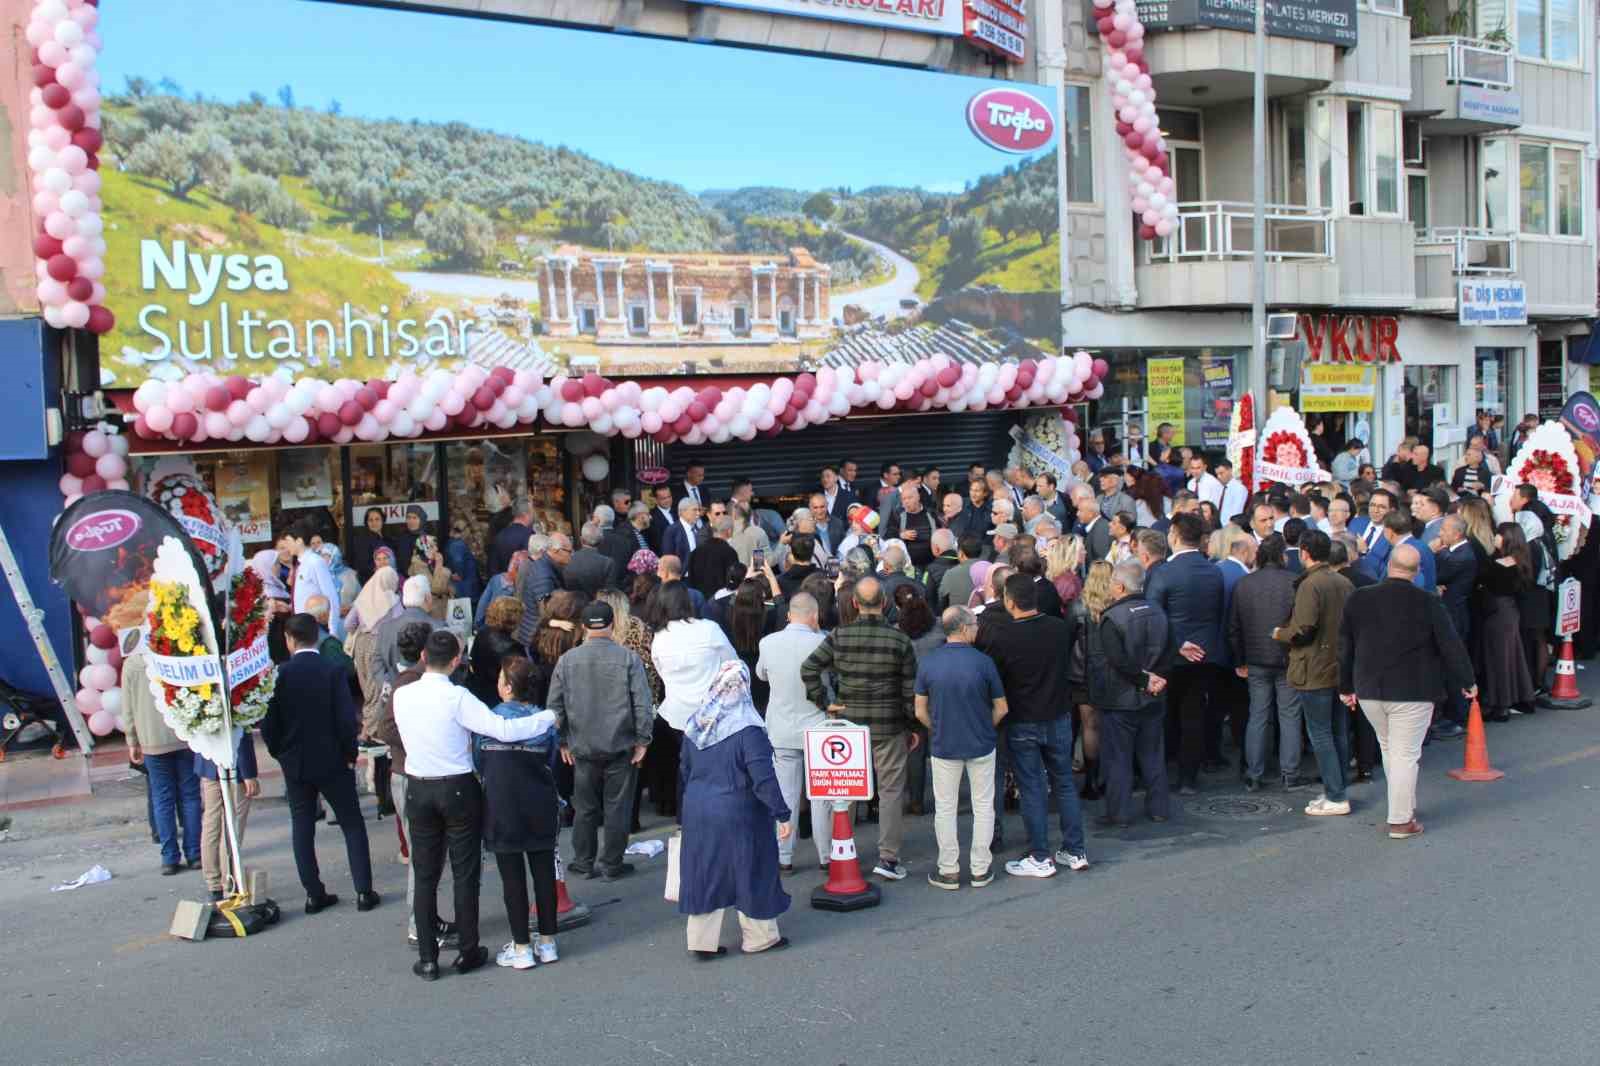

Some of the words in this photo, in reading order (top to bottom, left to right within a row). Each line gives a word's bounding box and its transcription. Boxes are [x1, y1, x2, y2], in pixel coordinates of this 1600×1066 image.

[140, 239, 288, 305] Nysa
[138, 302, 475, 361] Sultanhisar
[1293, 313, 1403, 363] VKUR
[231, 656, 269, 686] OSMAN
[827, 787, 849, 796] ALANI
